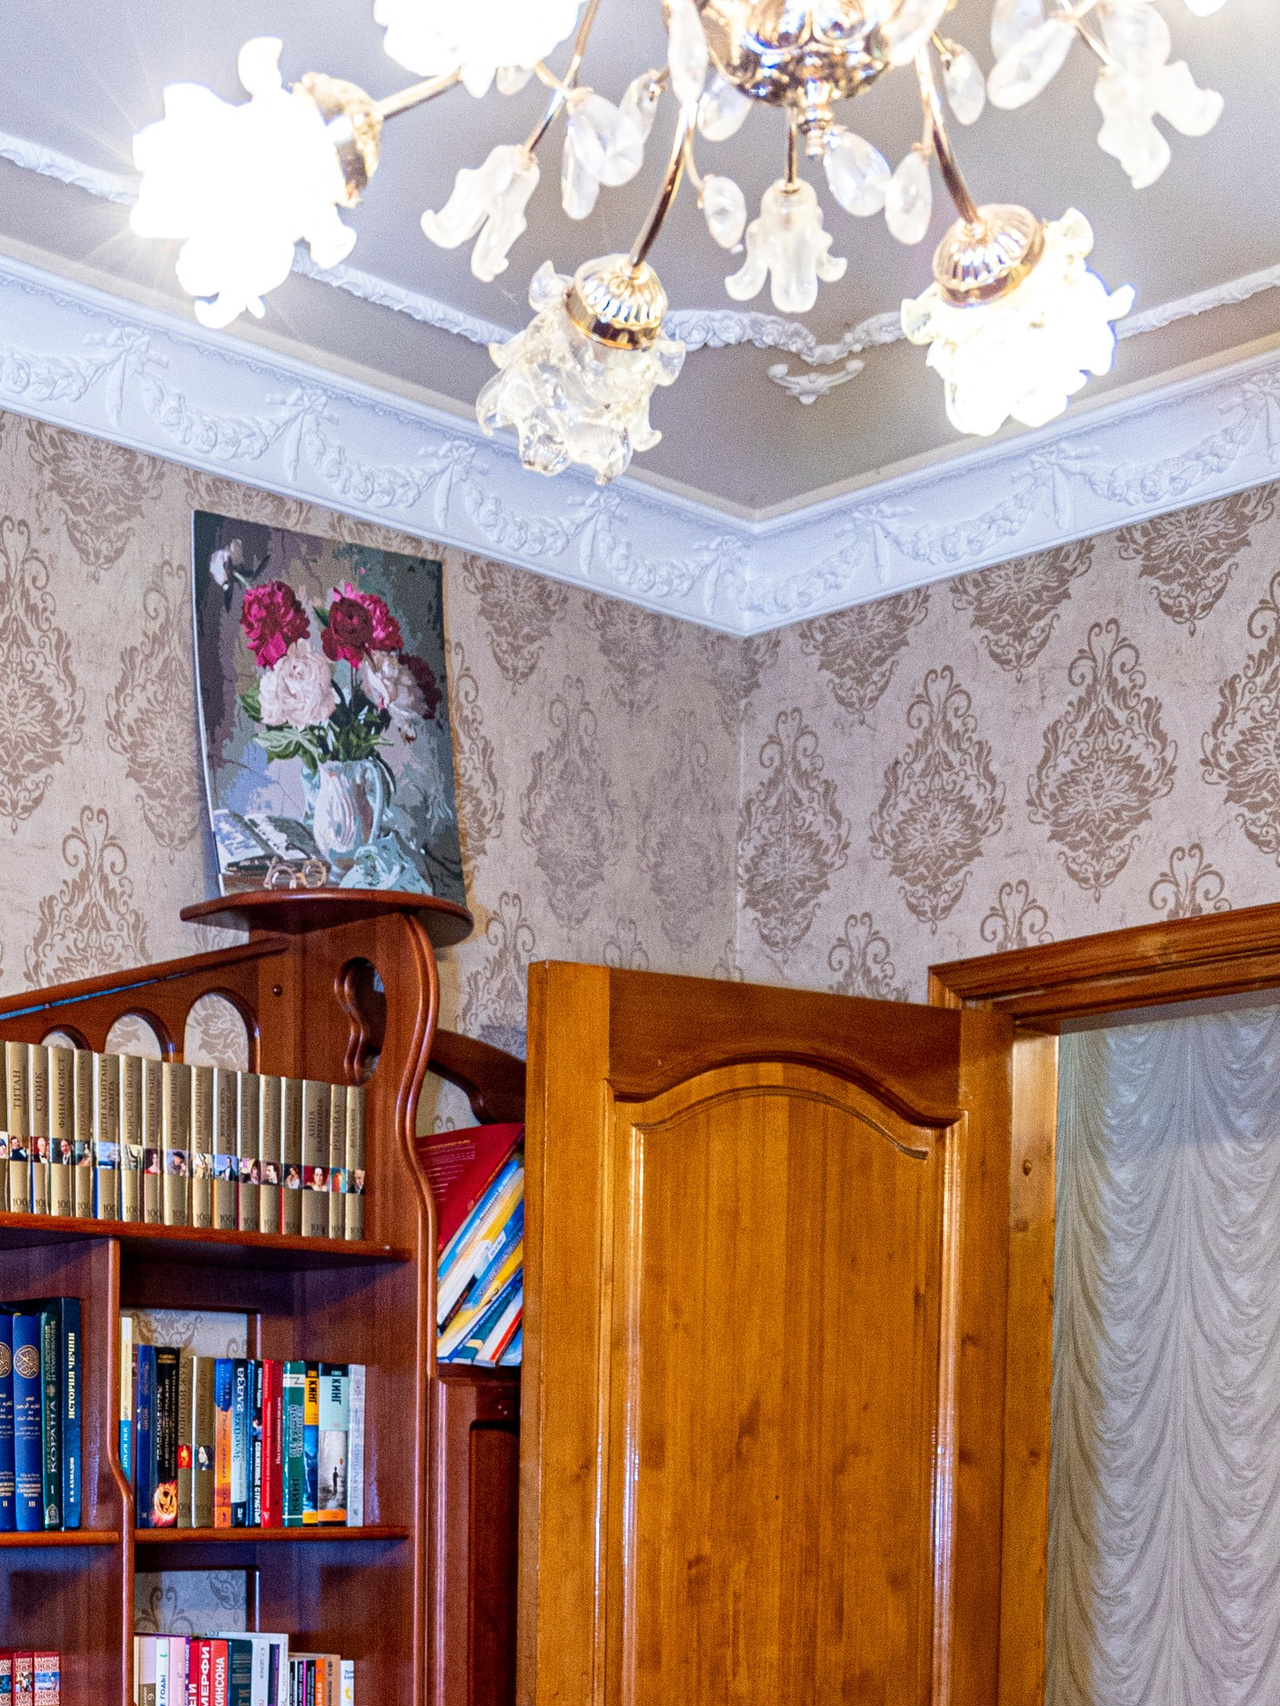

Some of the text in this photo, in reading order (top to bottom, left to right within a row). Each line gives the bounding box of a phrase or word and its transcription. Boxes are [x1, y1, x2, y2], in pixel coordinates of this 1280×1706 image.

[13, 1070, 22, 1109] ТИТАН
[34, 1072, 42, 1112] СТОИК
[57, 1056, 66, 1128] ФИНАНСИСТ
[308, 1380, 318, 1404] КИНГ
[332, 1378, 342, 1405] КИНГ
[232, 1414, 242, 1462] Зулейха
[289, 1477, 300, 1512] КИНГ
